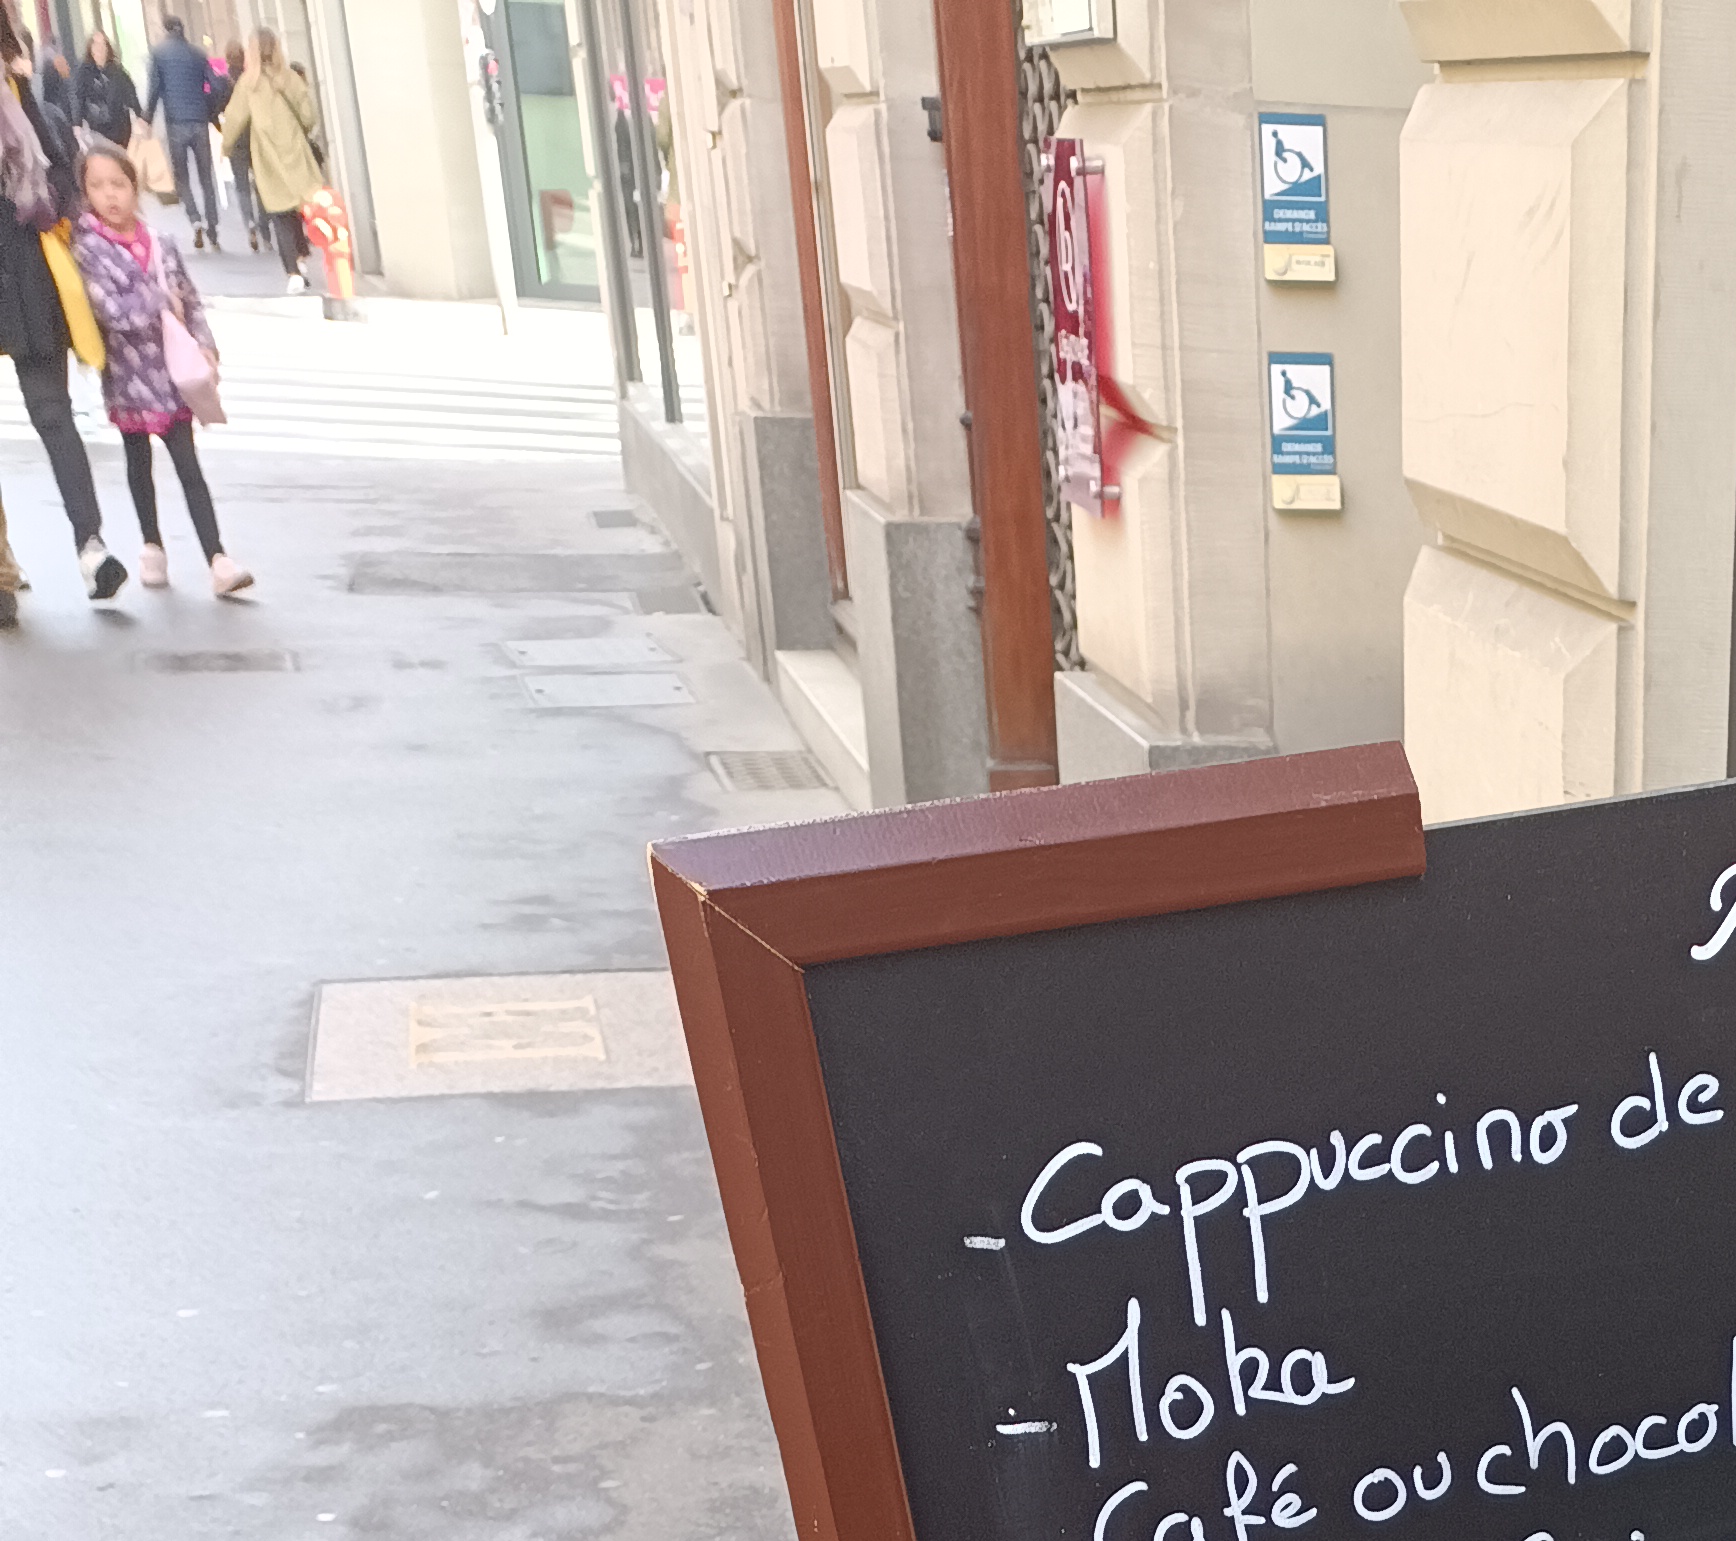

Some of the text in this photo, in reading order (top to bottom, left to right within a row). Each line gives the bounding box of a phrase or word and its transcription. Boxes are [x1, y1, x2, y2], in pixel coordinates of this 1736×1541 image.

[1019, 1091, 1580, 1328] Cappuccino
[1609, 1050, 1726, 1151] de
[1065, 1296, 1357, 1470] Moka
[1352, 1450, 1453, 1523] ou
